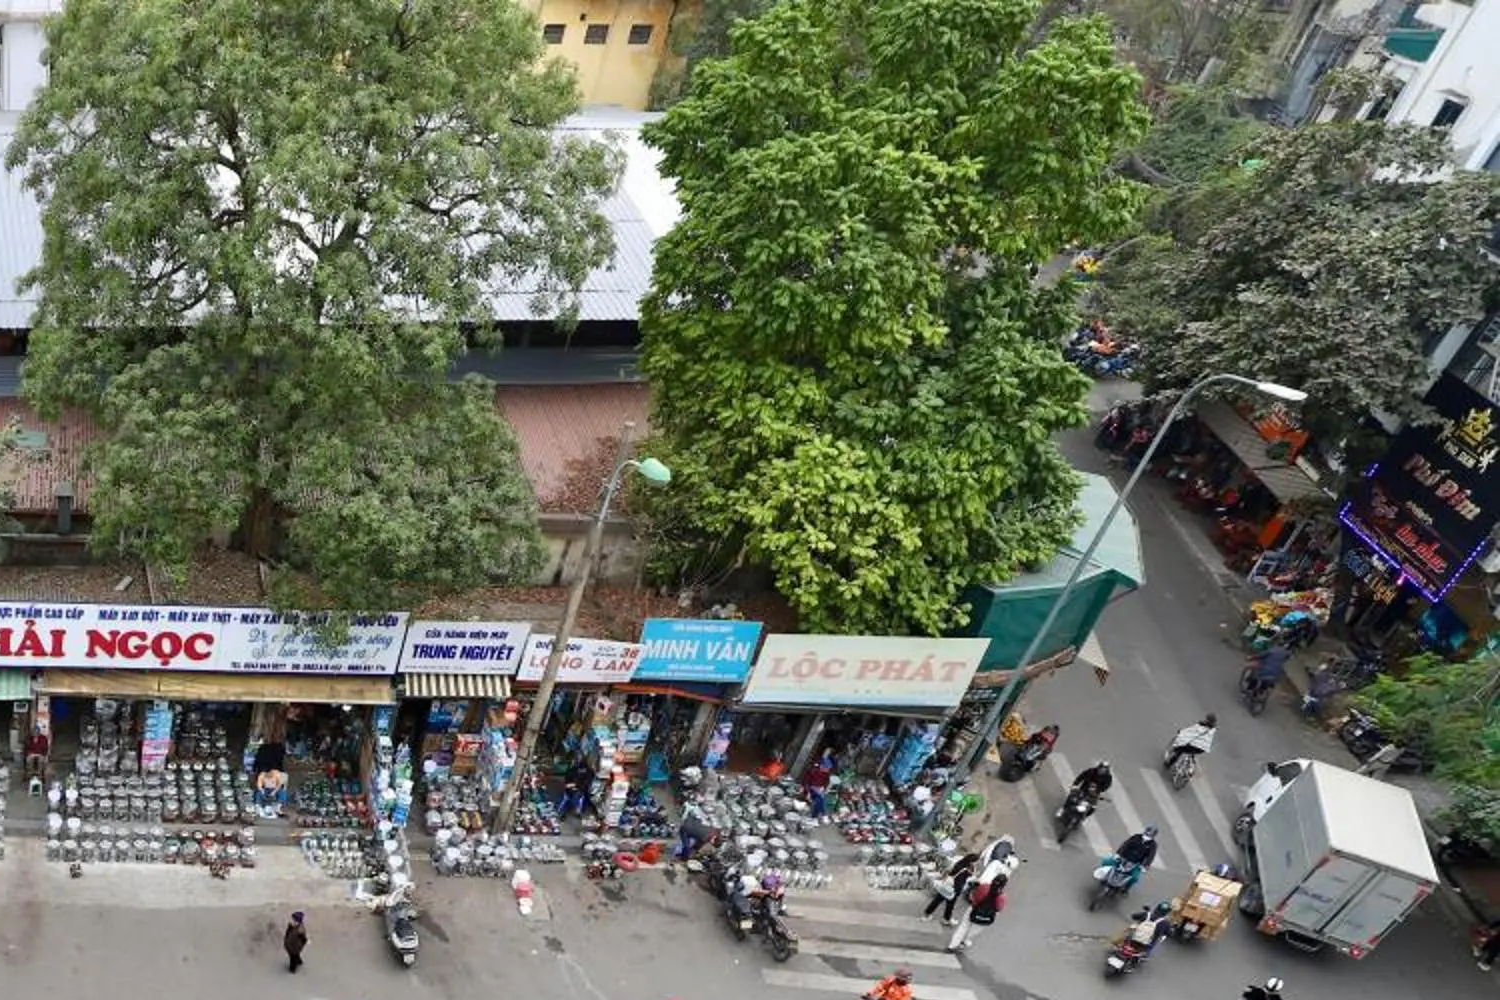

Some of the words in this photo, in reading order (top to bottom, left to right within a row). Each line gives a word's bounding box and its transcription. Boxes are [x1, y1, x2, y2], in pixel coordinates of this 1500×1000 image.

[44, 608, 62, 619] CAO
[85, 629, 215, 667] NGỌC
[412, 643, 457, 660] TRUNG
[645, 638, 701, 660] MINH
[767, 650, 847, 683] LỘC
[854, 655, 967, 683] PHÁT
